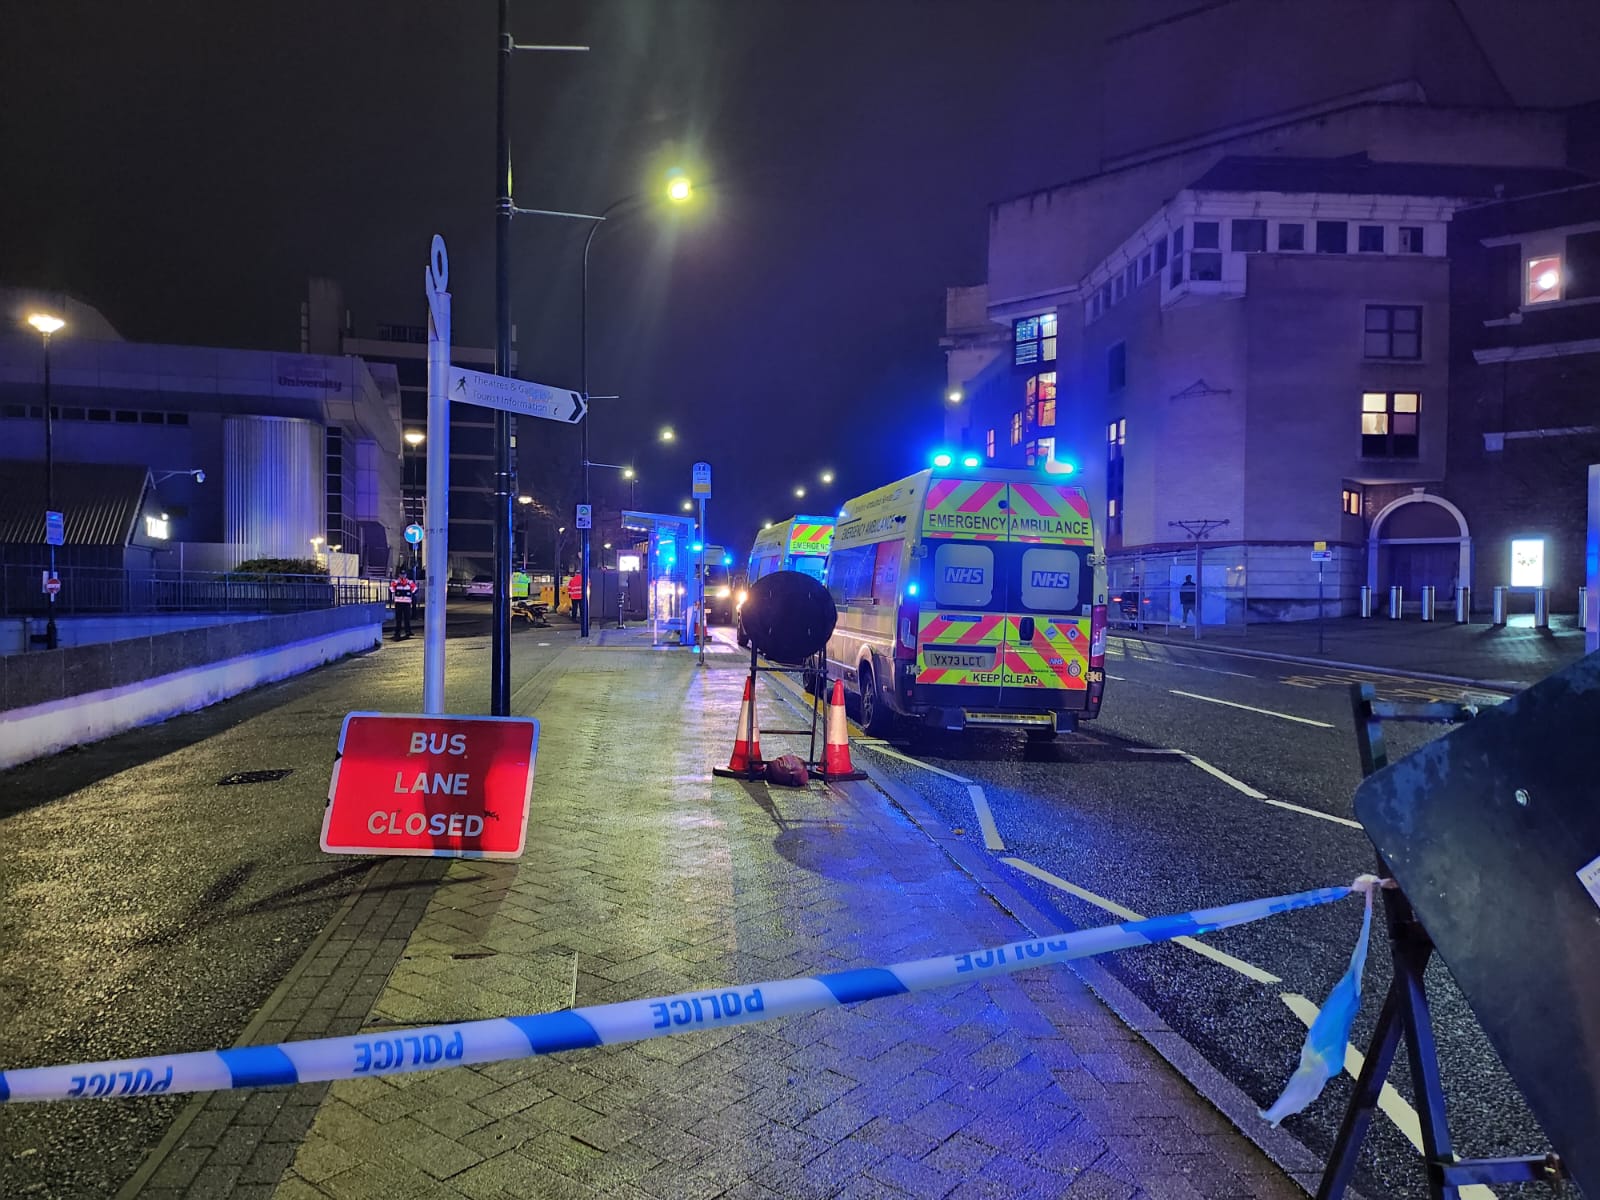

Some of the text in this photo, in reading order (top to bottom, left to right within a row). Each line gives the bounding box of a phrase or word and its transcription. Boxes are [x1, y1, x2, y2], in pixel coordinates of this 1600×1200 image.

[277, 376, 342, 392] University
[473, 375, 517, 391] Theatres &
[473, 390, 548, 411] Tourist Information
[929, 513, 1089, 535] EMERGENCY AMBULANCE
[946, 568, 983, 583] NHS
[1032, 572, 1069, 588] NHS
[934, 655, 960, 666] YX73
[973, 673, 1038, 684] KEEP CLEAR
[409, 732, 466, 755] BUS
[394, 772, 469, 795] LANE
[367, 810, 483, 837] CLOSED
[653, 988, 765, 1029] POLICE
[353, 1031, 464, 1073] POLICE
[67, 1064, 174, 1097] POLICE
